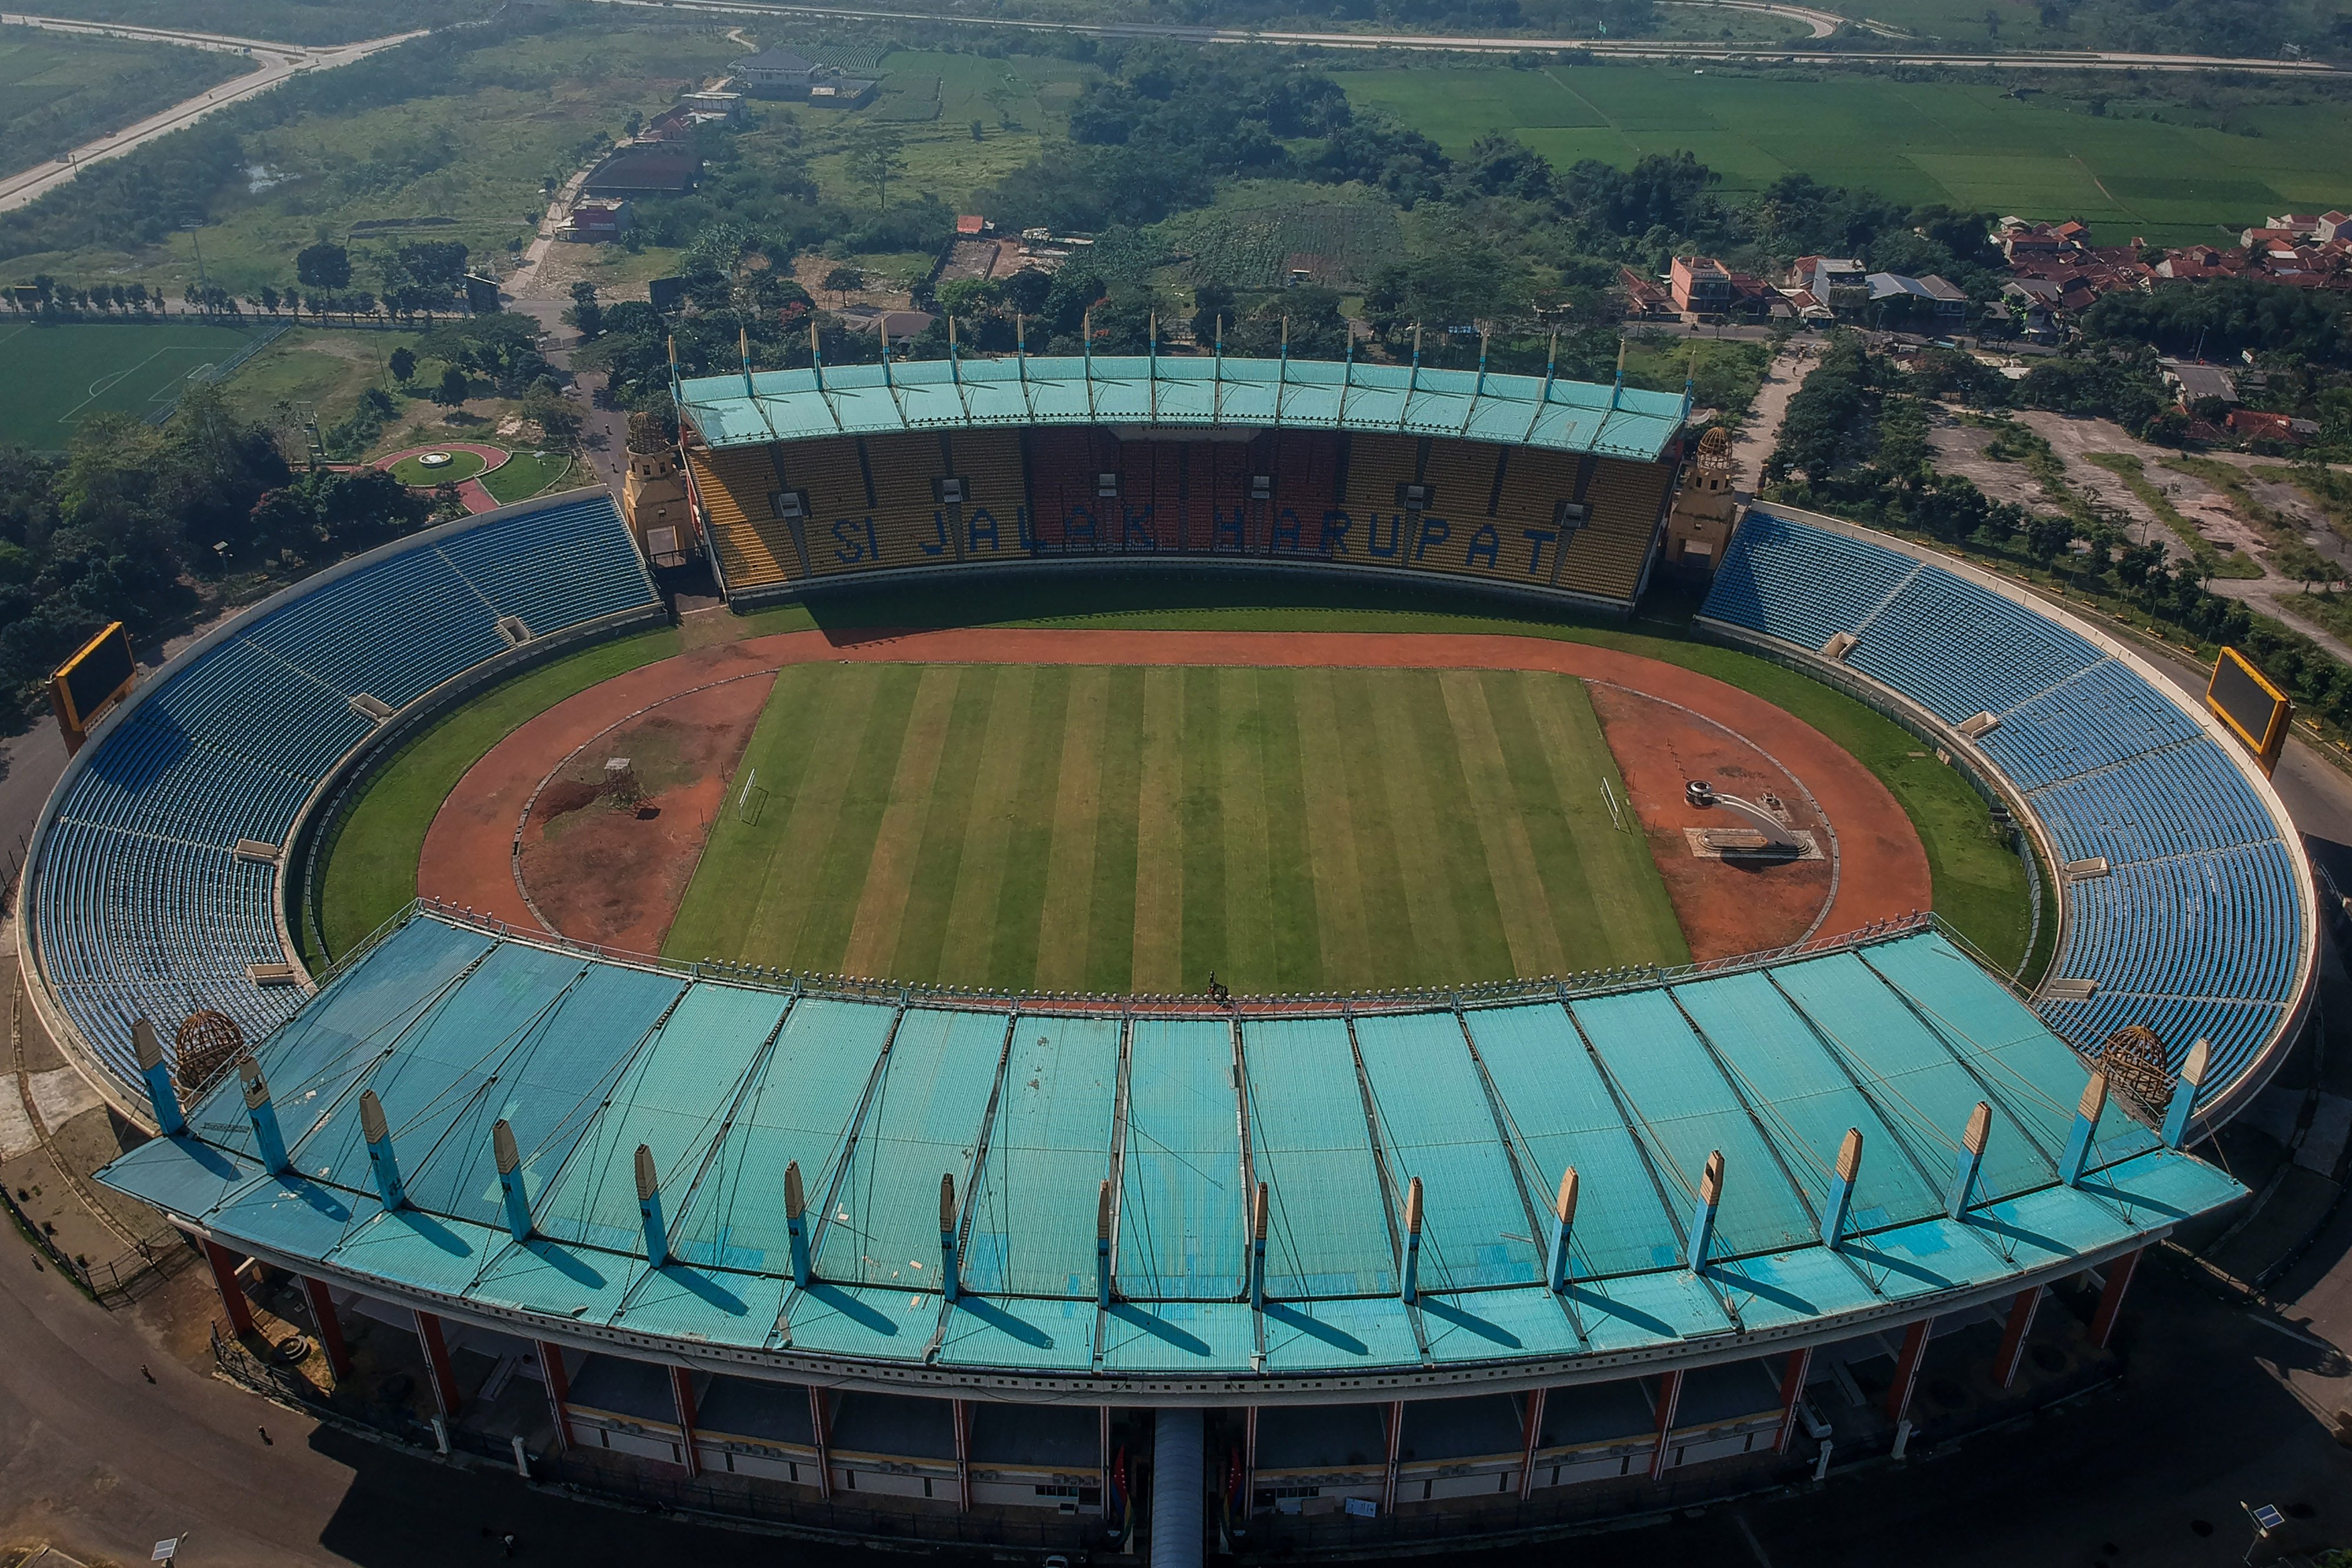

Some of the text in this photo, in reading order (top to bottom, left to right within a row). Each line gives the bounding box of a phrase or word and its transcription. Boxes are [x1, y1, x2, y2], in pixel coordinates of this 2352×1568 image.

[831, 504, 1556, 574] SI JALAK HARUPAT
